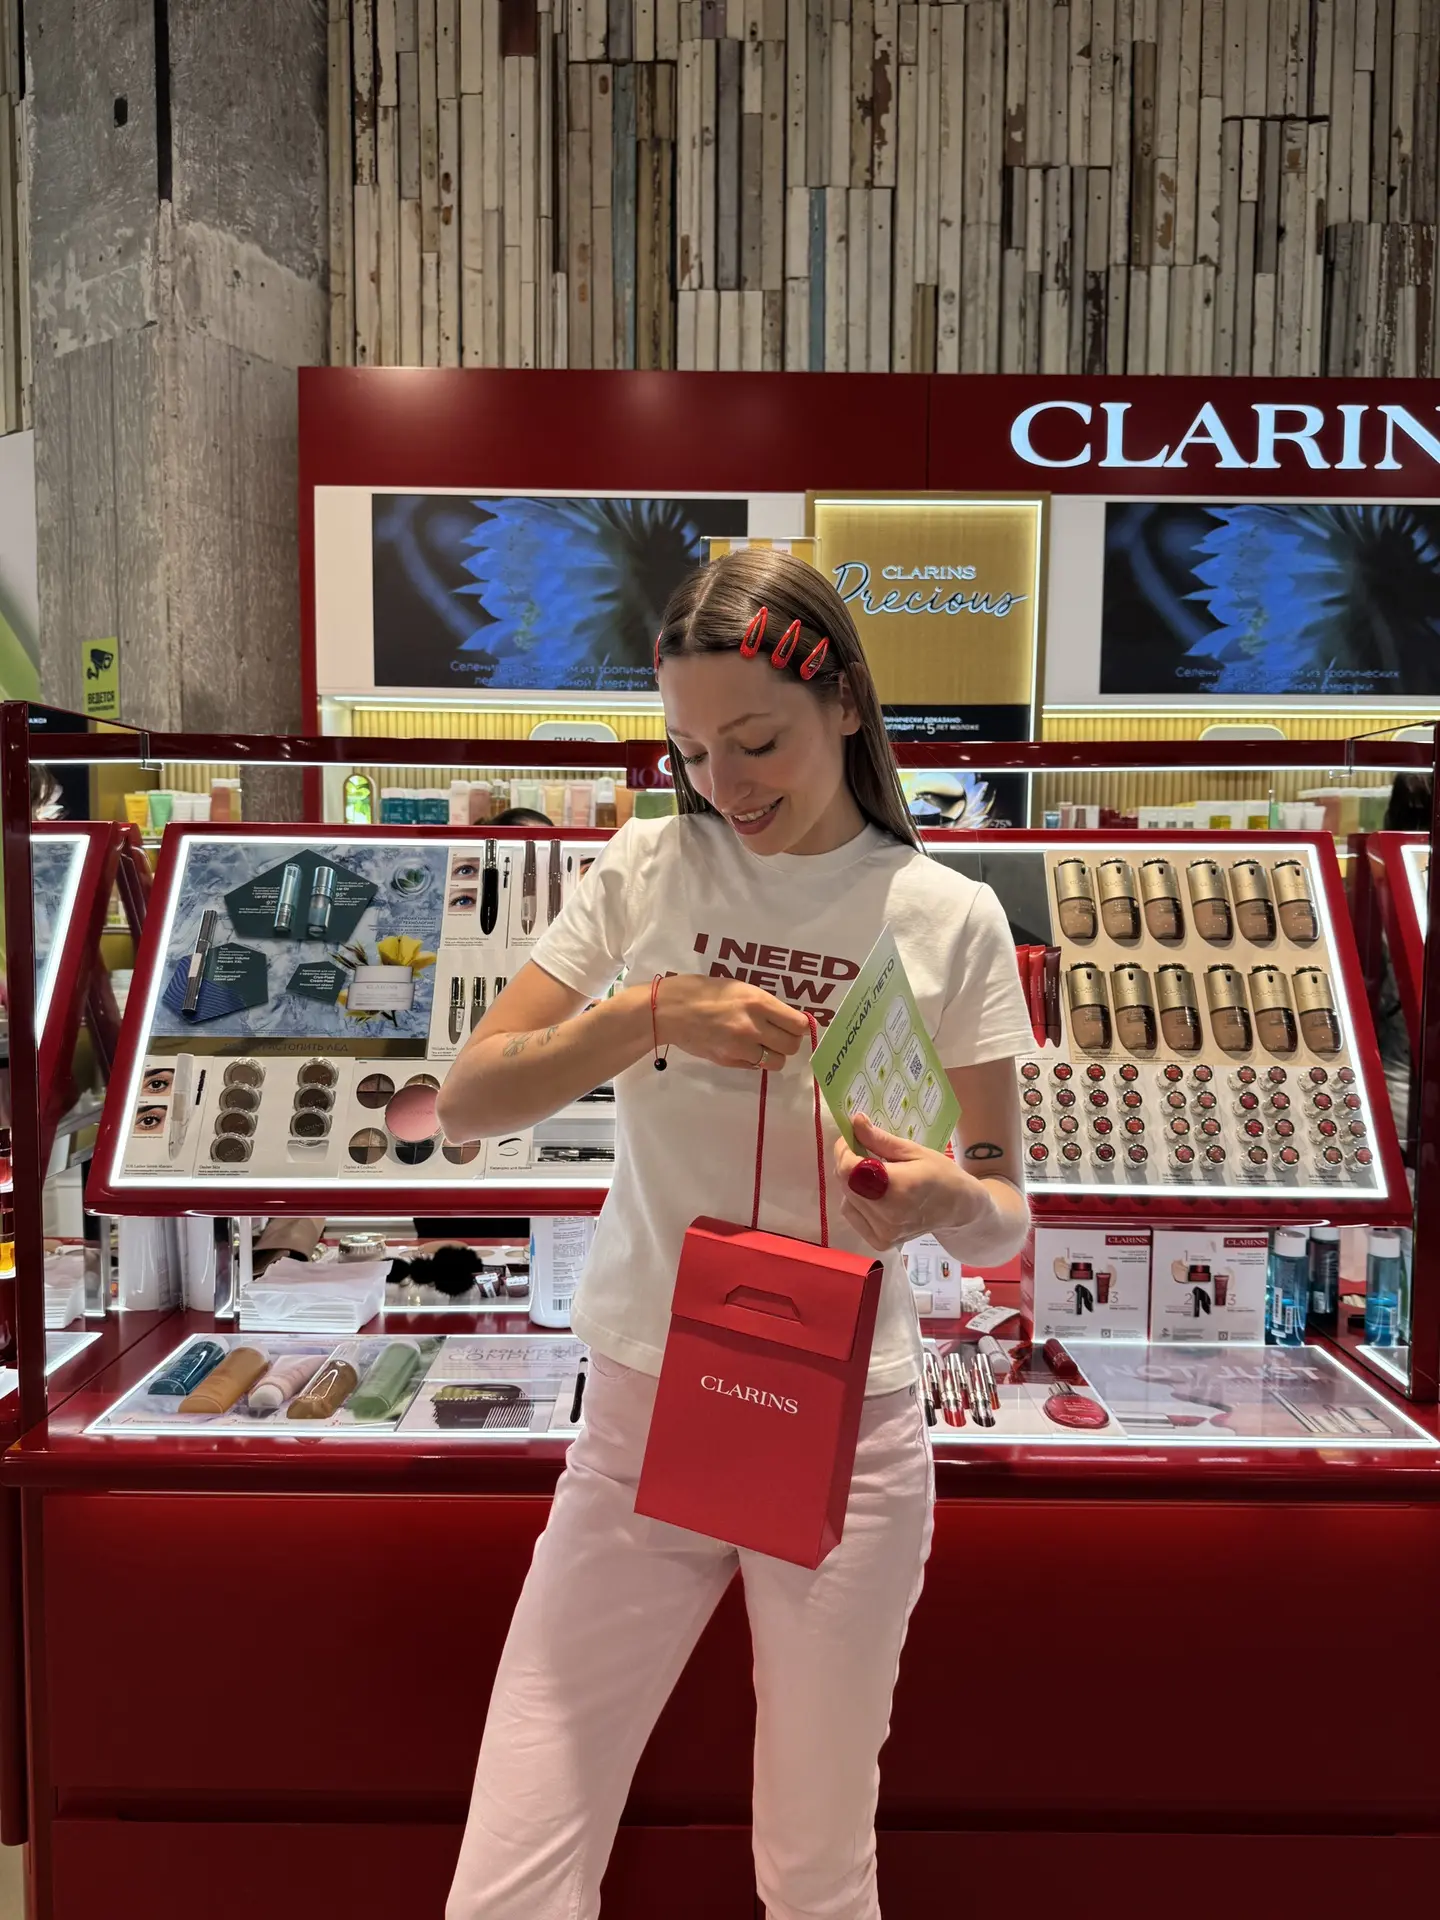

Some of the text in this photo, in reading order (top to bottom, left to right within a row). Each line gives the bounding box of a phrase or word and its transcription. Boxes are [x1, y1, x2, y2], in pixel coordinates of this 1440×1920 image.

[1010, 401, 1440, 470] CLARIN
[882, 565, 977, 580] CLARINS
[832, 560, 1029, 618] Precious
[926, 723, 936, 735] 5
[693, 933, 860, 980] I NEED
[709, 962, 836, 1004] NEW
[872, 958, 895, 1001] ЛЕТО
[824, 1000, 872, 1087] ЗАПУСКАЙ
[1107, 1236, 1149, 1244] CLARINS
[1065, 1247, 1070, 1259] 1
[1184, 1250, 1188, 1261] 1
[1066, 1291, 1075, 1302] 2
[1110, 1291, 1118, 1303] 3
[1184, 1293, 1193, 1305] 2
[1227, 1294, 1236, 1305] 3
[448, 1352, 568, 1361] COMPLEX
[700, 1375, 798, 1414] CLARINS
